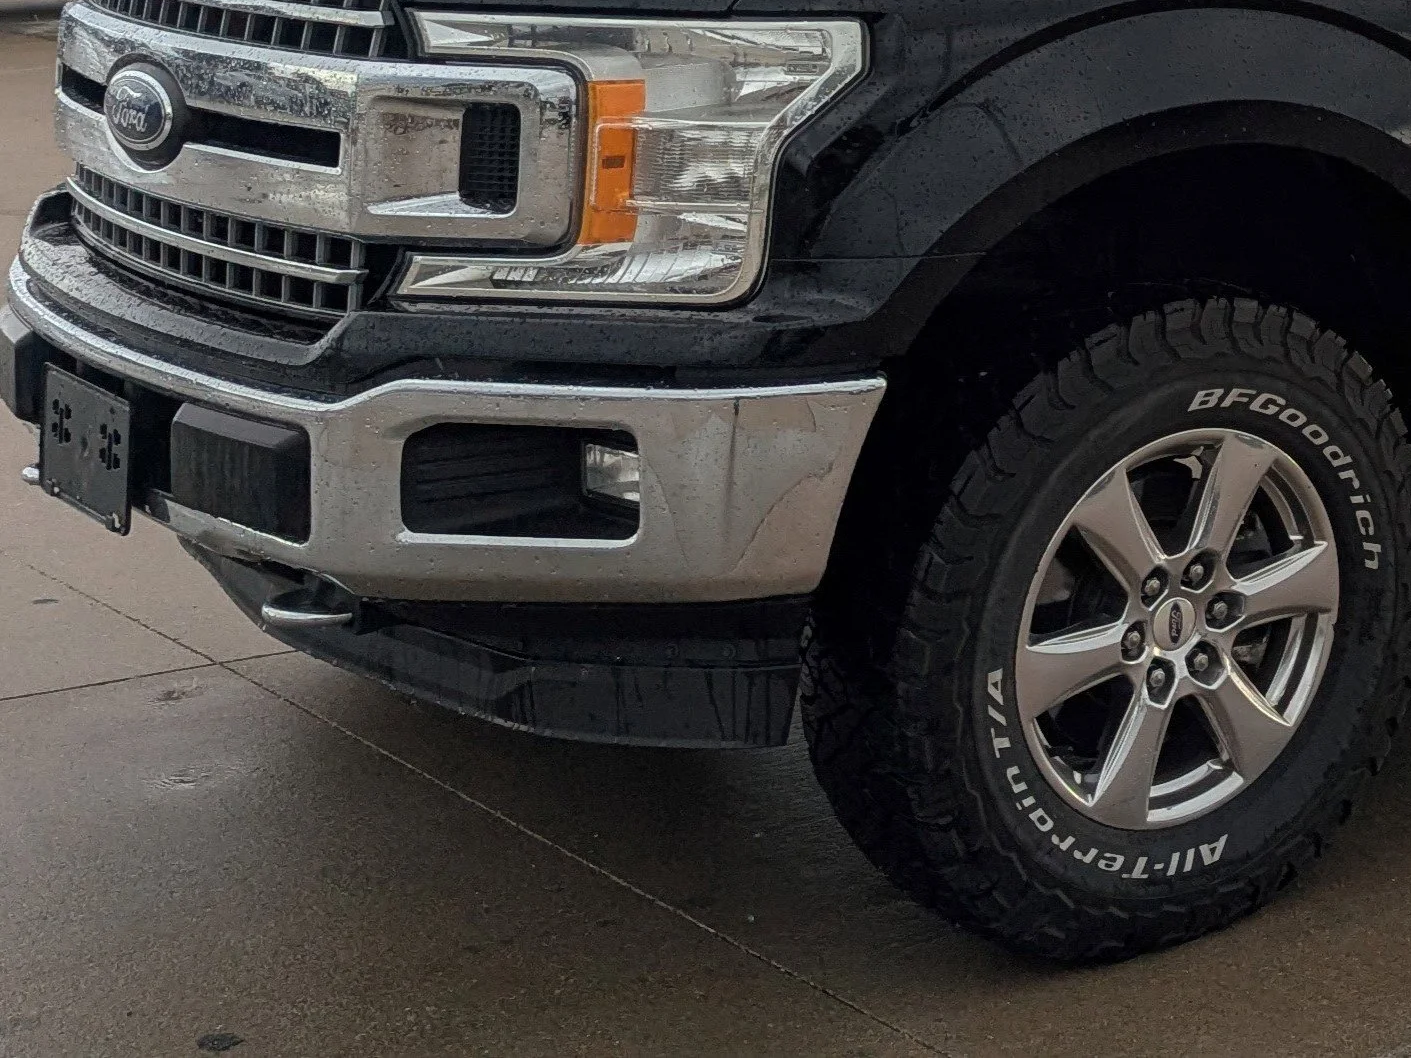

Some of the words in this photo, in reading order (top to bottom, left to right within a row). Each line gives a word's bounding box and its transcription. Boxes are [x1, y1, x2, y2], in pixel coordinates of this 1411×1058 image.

[111, 85, 148, 133] Ford
[1187, 388, 1382, 570] BFGoodrich
[987, 667, 1012, 759] T/A
[1006, 765, 1229, 879] All-Terrain
